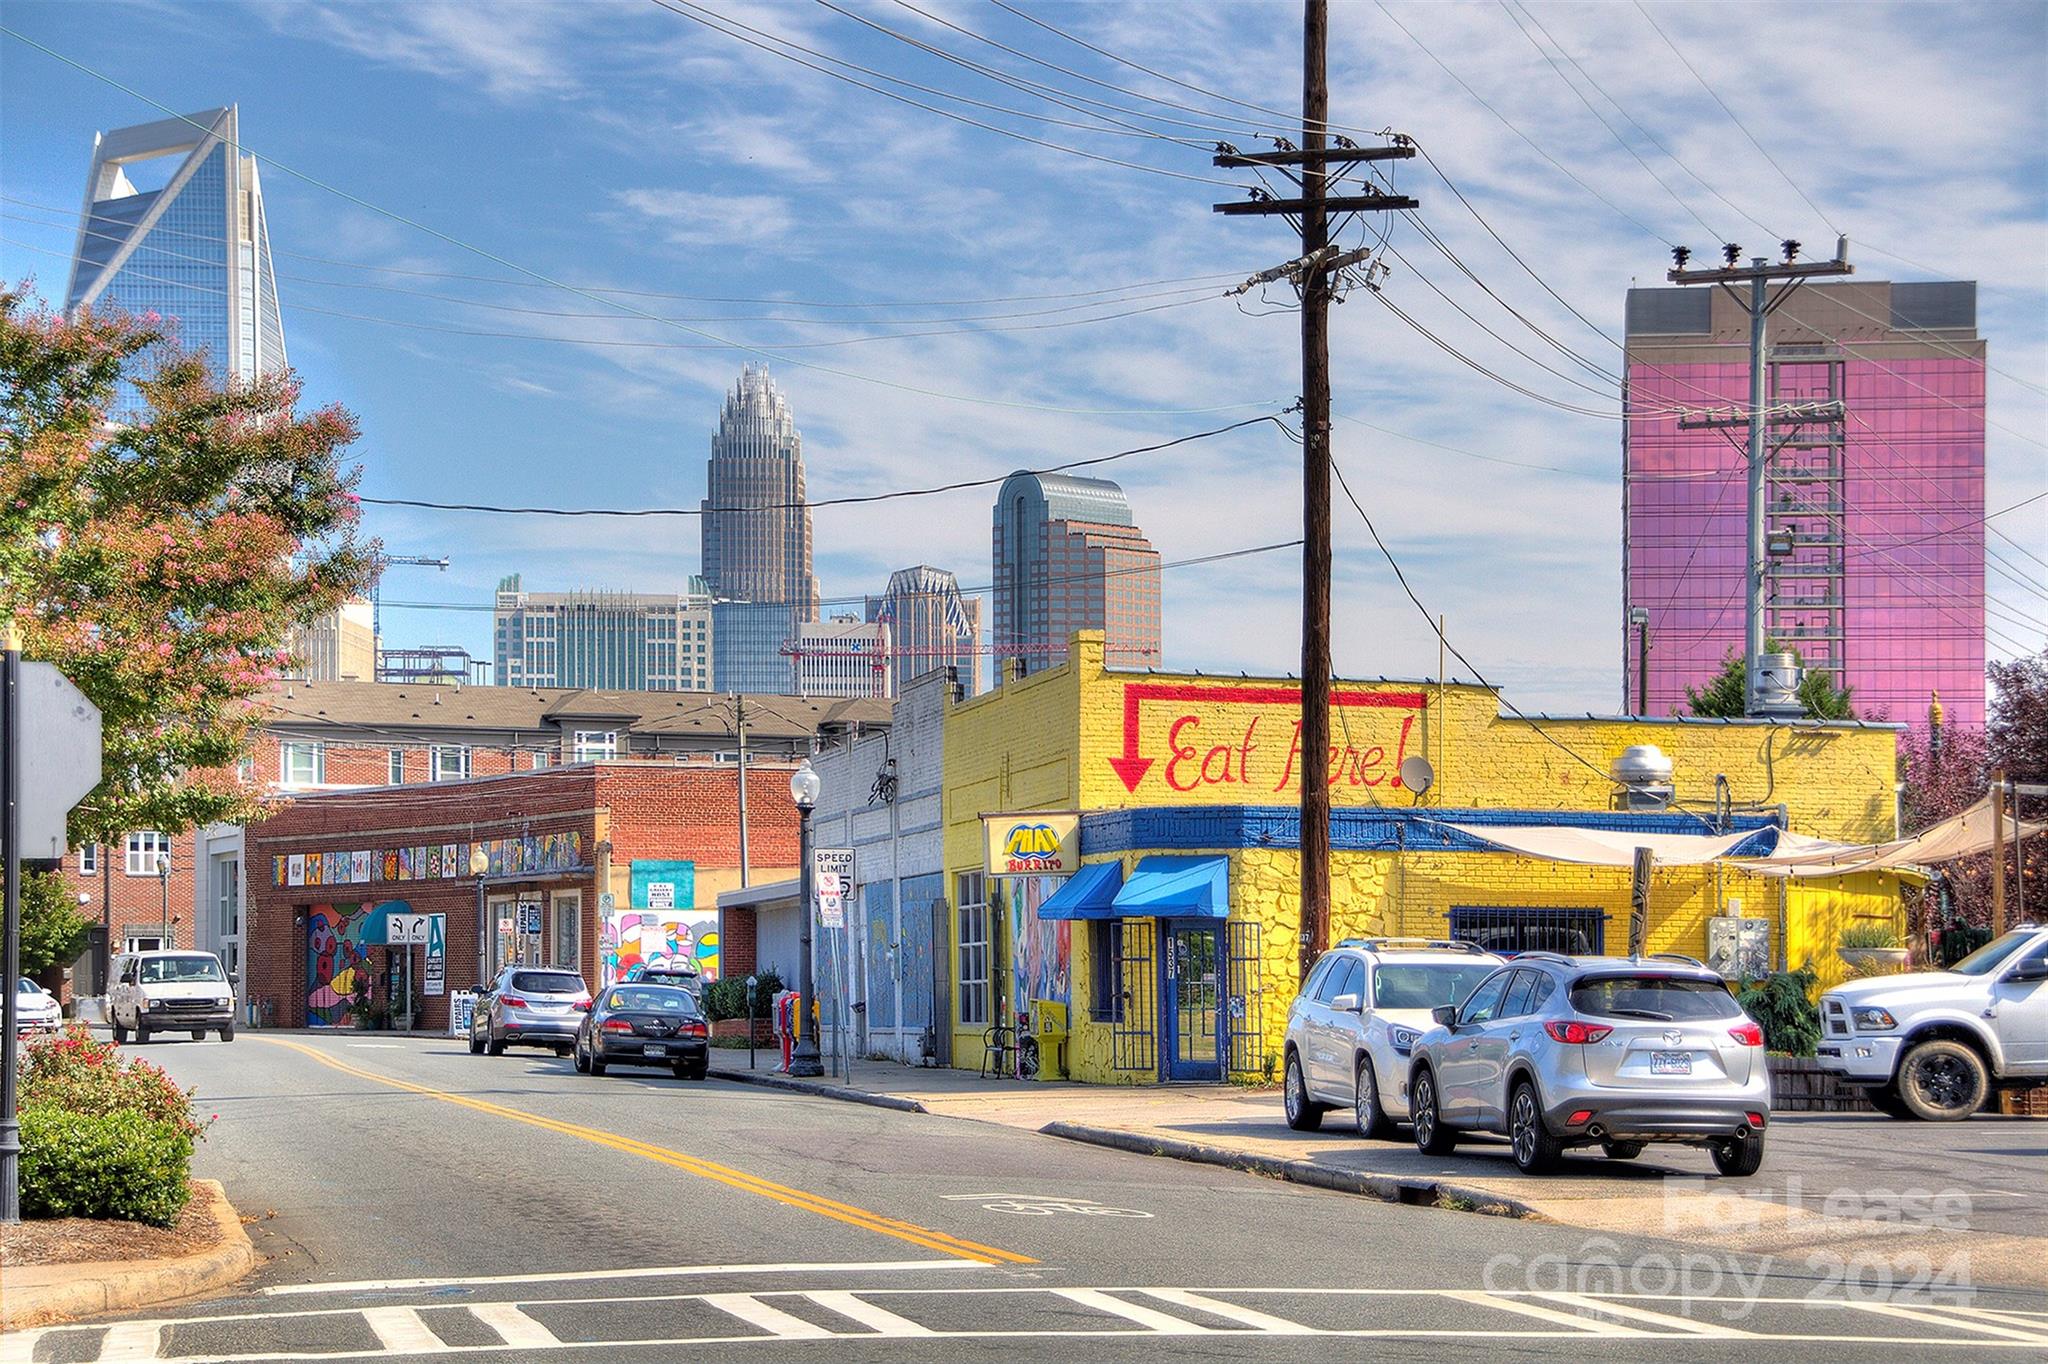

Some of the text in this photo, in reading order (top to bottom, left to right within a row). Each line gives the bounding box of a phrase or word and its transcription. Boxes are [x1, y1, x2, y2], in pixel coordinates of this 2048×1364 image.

[1164, 715, 1260, 792] Eat
[816, 853, 853, 862] SPEED
[1007, 859, 1062, 872] BURRITO
[820, 865, 848, 873] LIMIT
[1168, 937, 1176, 979] 1537
[454, 998, 463, 1030] REPAIRS
